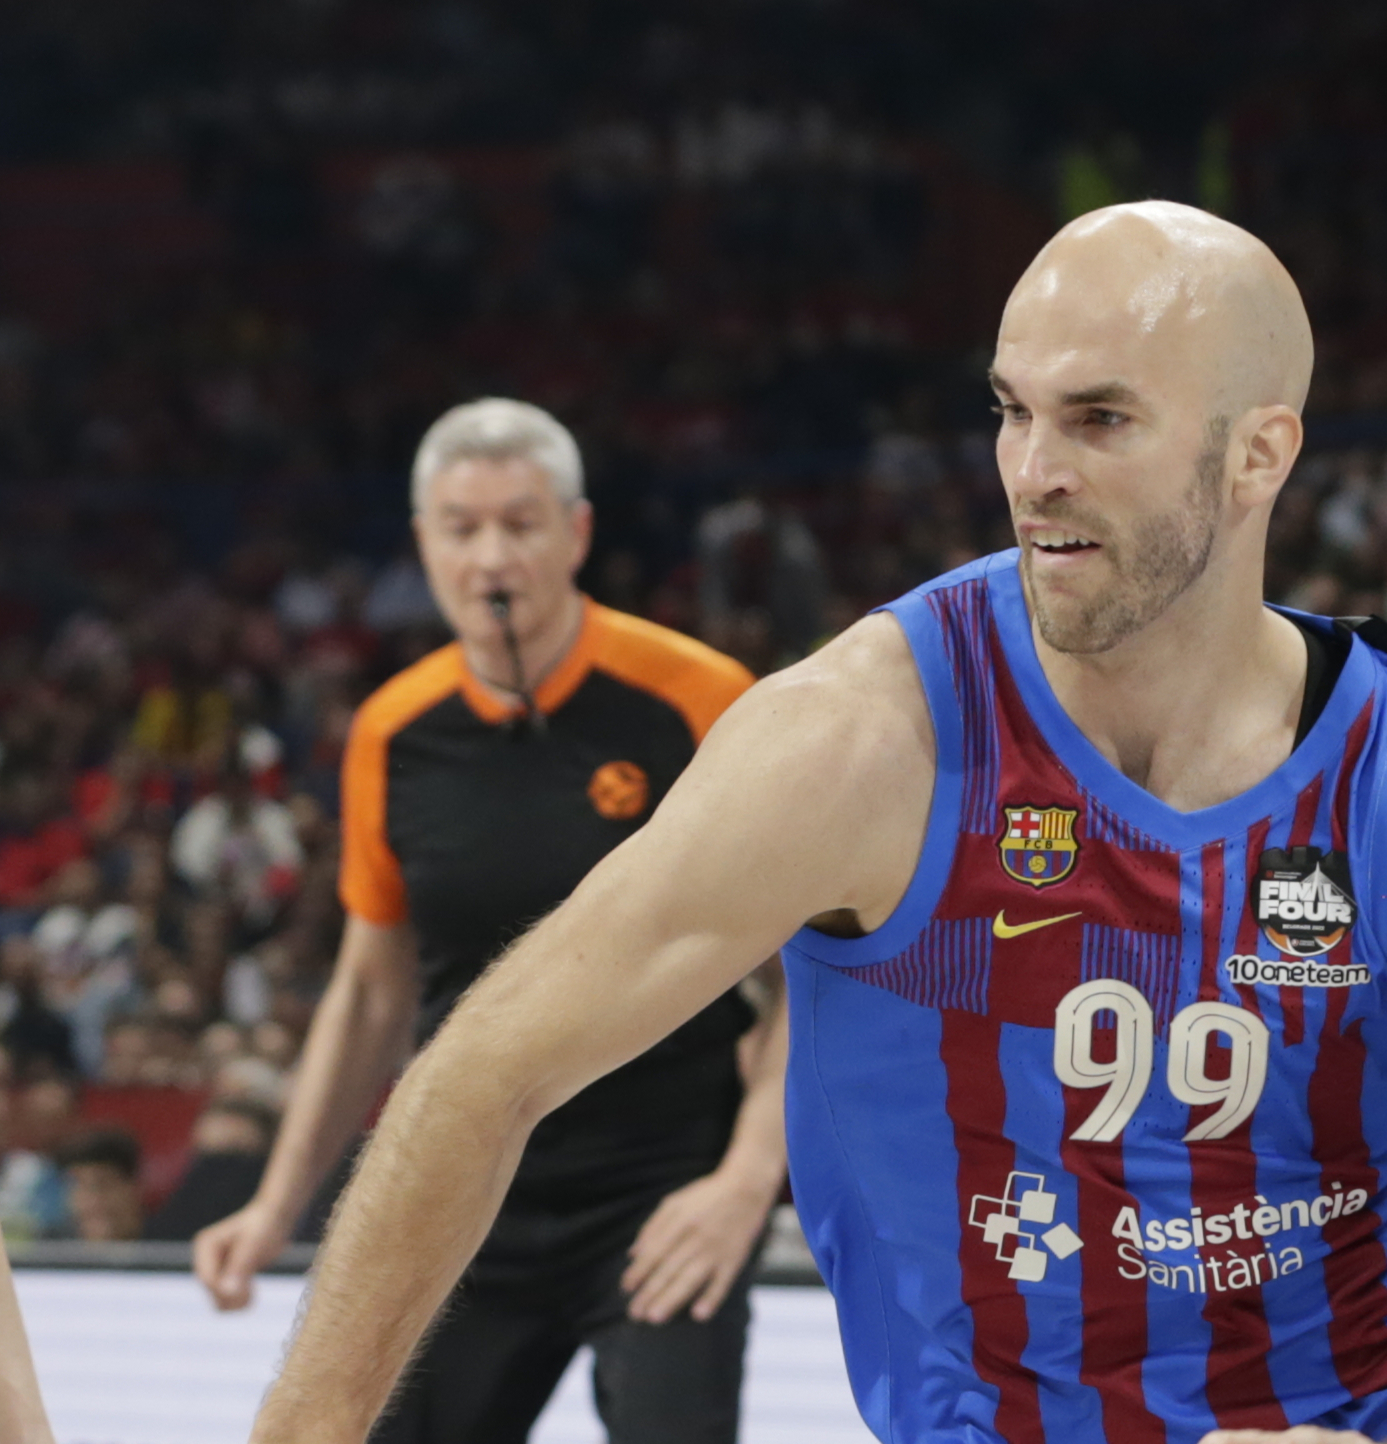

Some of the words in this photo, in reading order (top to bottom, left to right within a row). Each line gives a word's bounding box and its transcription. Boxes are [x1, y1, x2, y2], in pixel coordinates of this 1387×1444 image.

[1258, 899, 1352, 924] FOUR
[1053, 977, 1270, 1143] 99
[1111, 1180, 1369, 1254] Assistència
[1116, 1240, 1304, 1295] Sanitària
